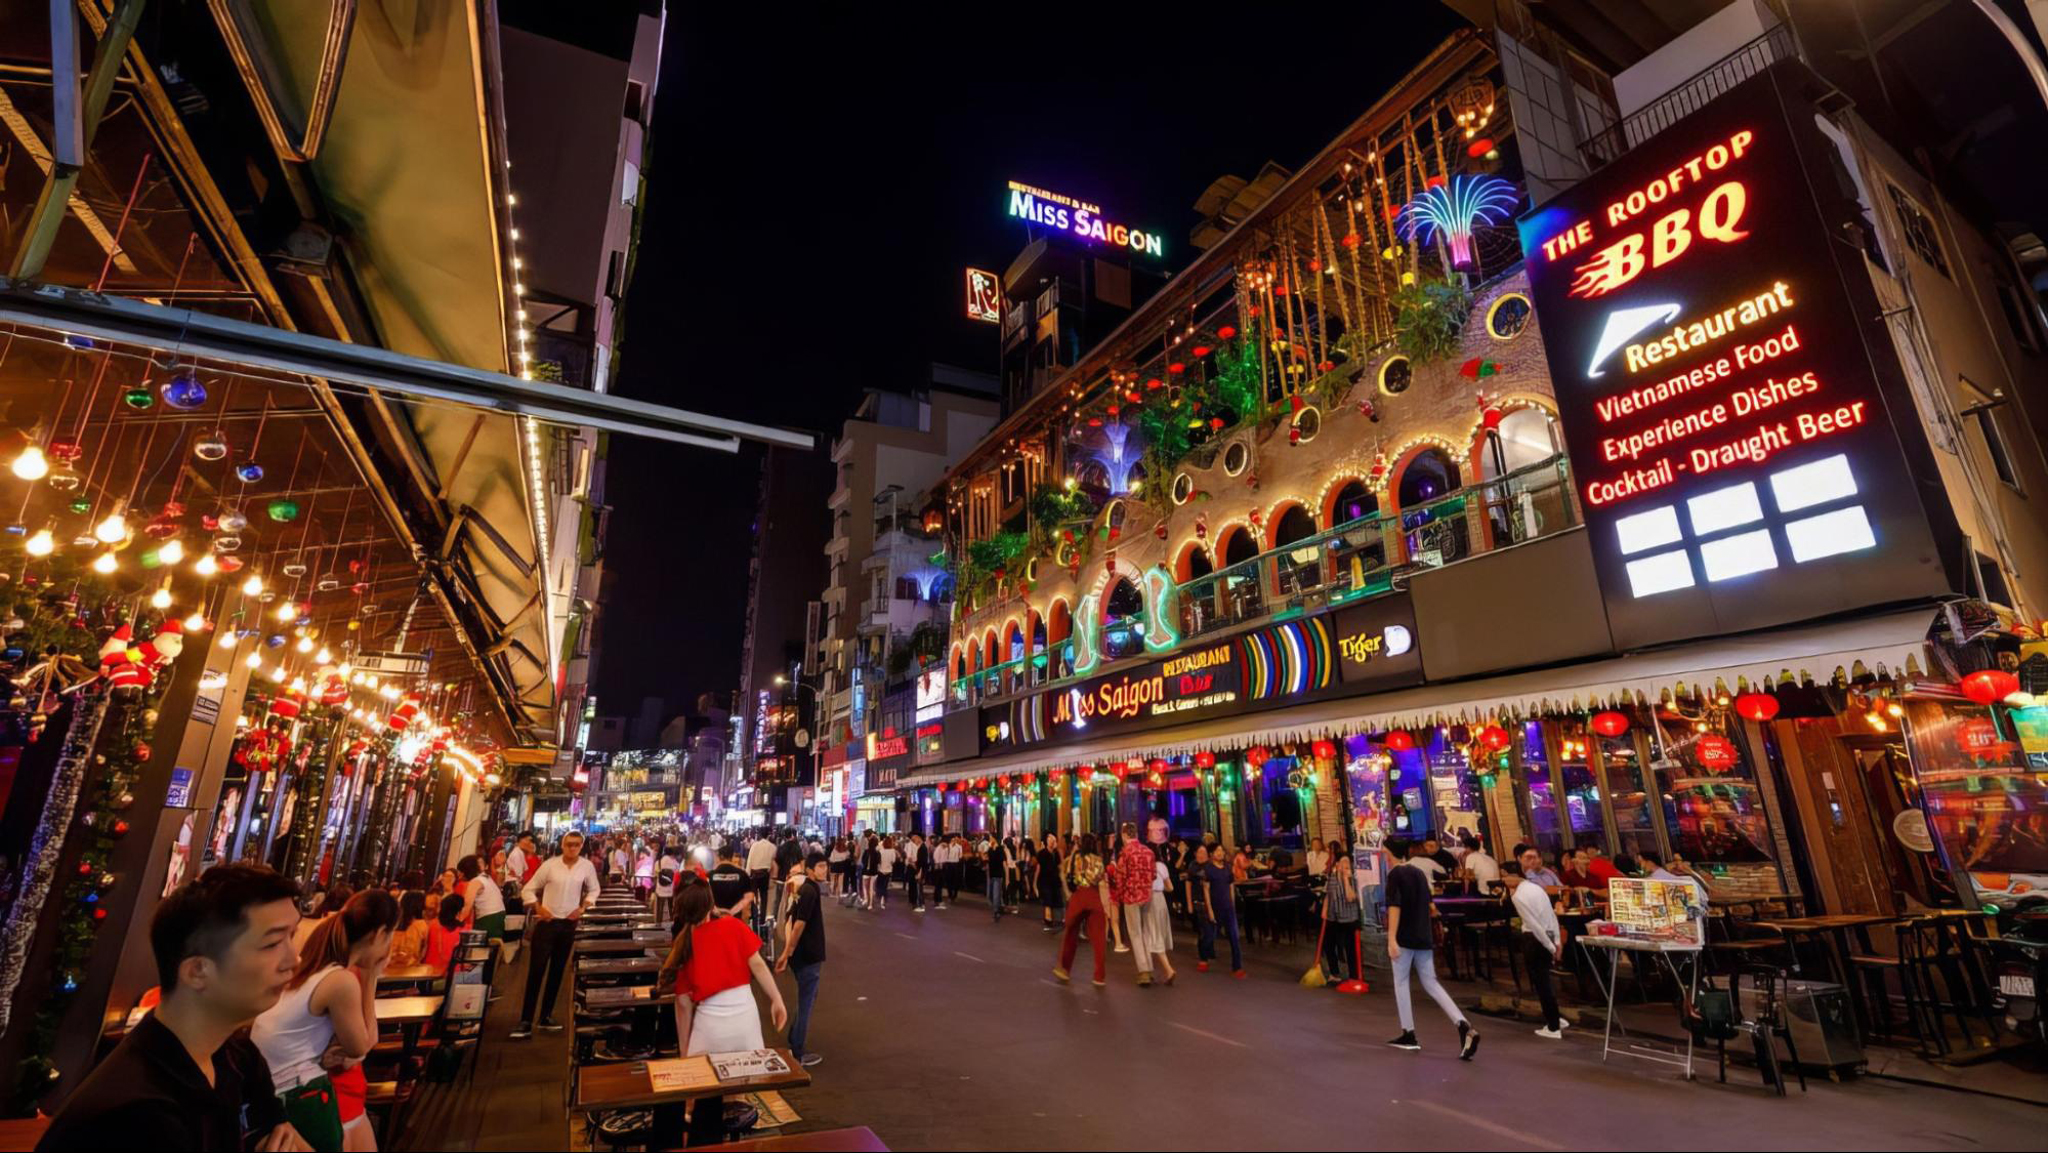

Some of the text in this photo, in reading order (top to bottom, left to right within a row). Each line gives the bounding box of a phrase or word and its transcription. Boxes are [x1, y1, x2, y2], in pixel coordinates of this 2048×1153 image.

[1009, 190, 1162, 257] MISS SAIGON
[1542, 130, 1753, 262] THE ROOFTOP
[1570, 181, 1749, 298] BBQ
[1625, 281, 1793, 373] Restaurant
[1598, 326, 1800, 422] Vietnamese Food
[1603, 372, 1818, 461] Experience Dishes
[1588, 458, 1673, 505] Cocktail
[1691, 423, 1792, 474] Draught
[1797, 402, 1865, 440] Beer
[1338, 632, 1382, 663] Tiger
[1098, 676, 1164, 718] Saigon
